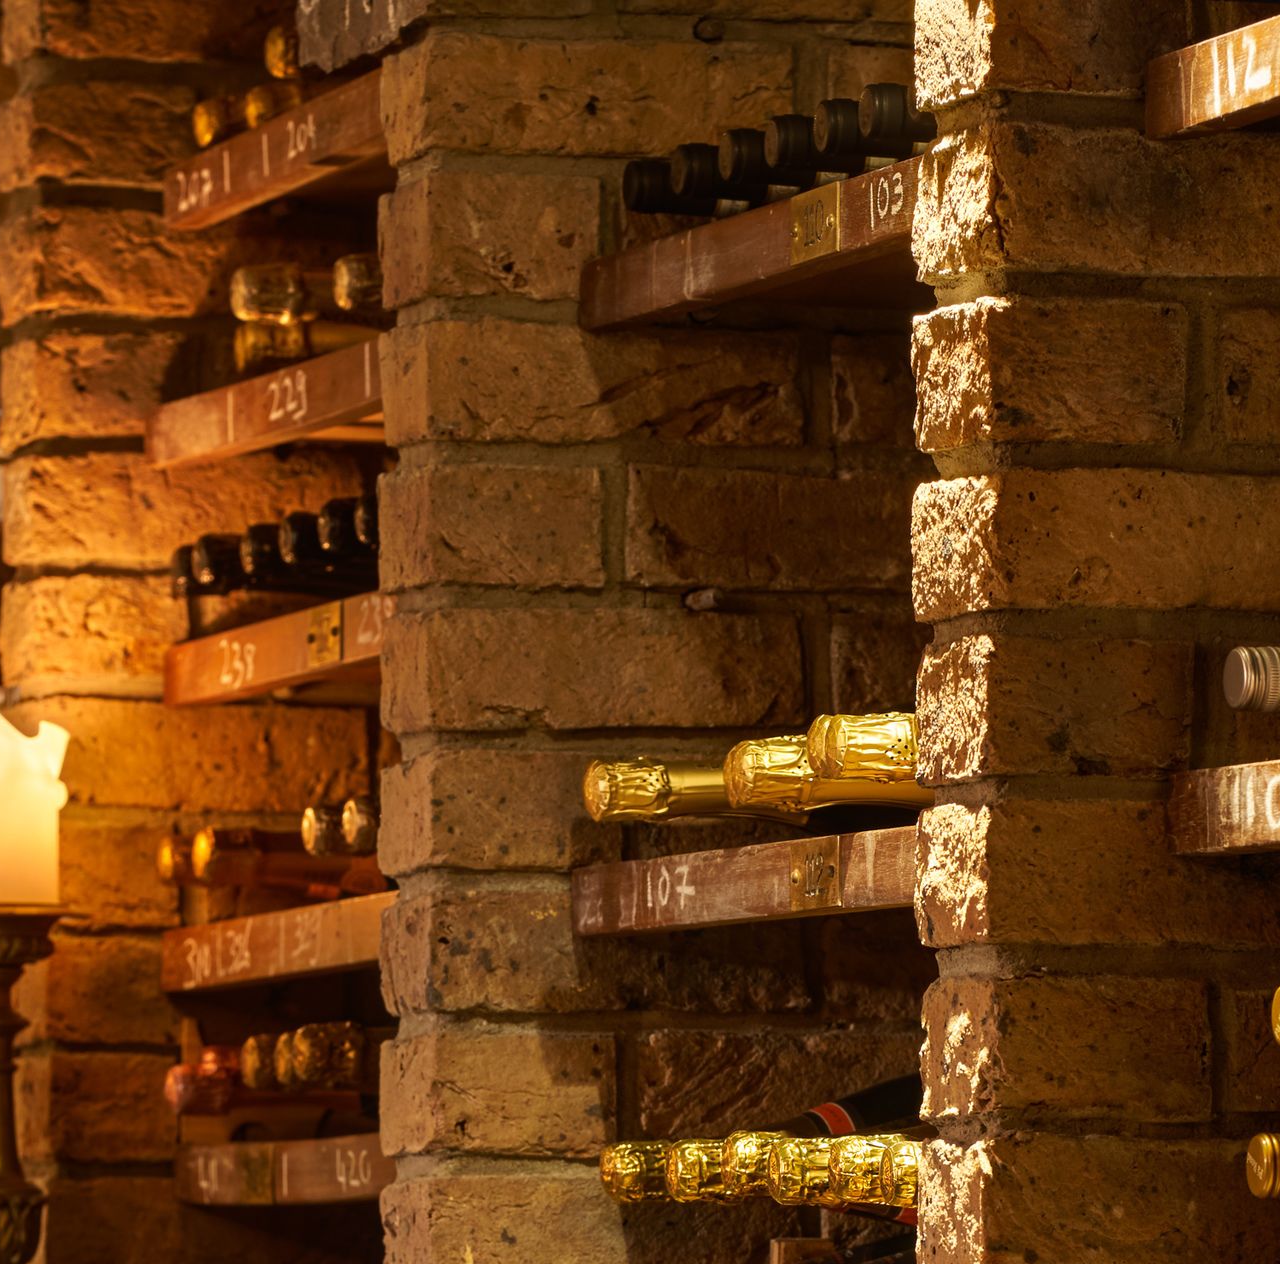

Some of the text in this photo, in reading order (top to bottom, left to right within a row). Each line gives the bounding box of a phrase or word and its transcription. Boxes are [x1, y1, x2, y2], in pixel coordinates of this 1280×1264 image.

[1210, 36, 1272, 118] 112
[870, 172, 903, 232] 103
[646, 864, 696, 910] 107
